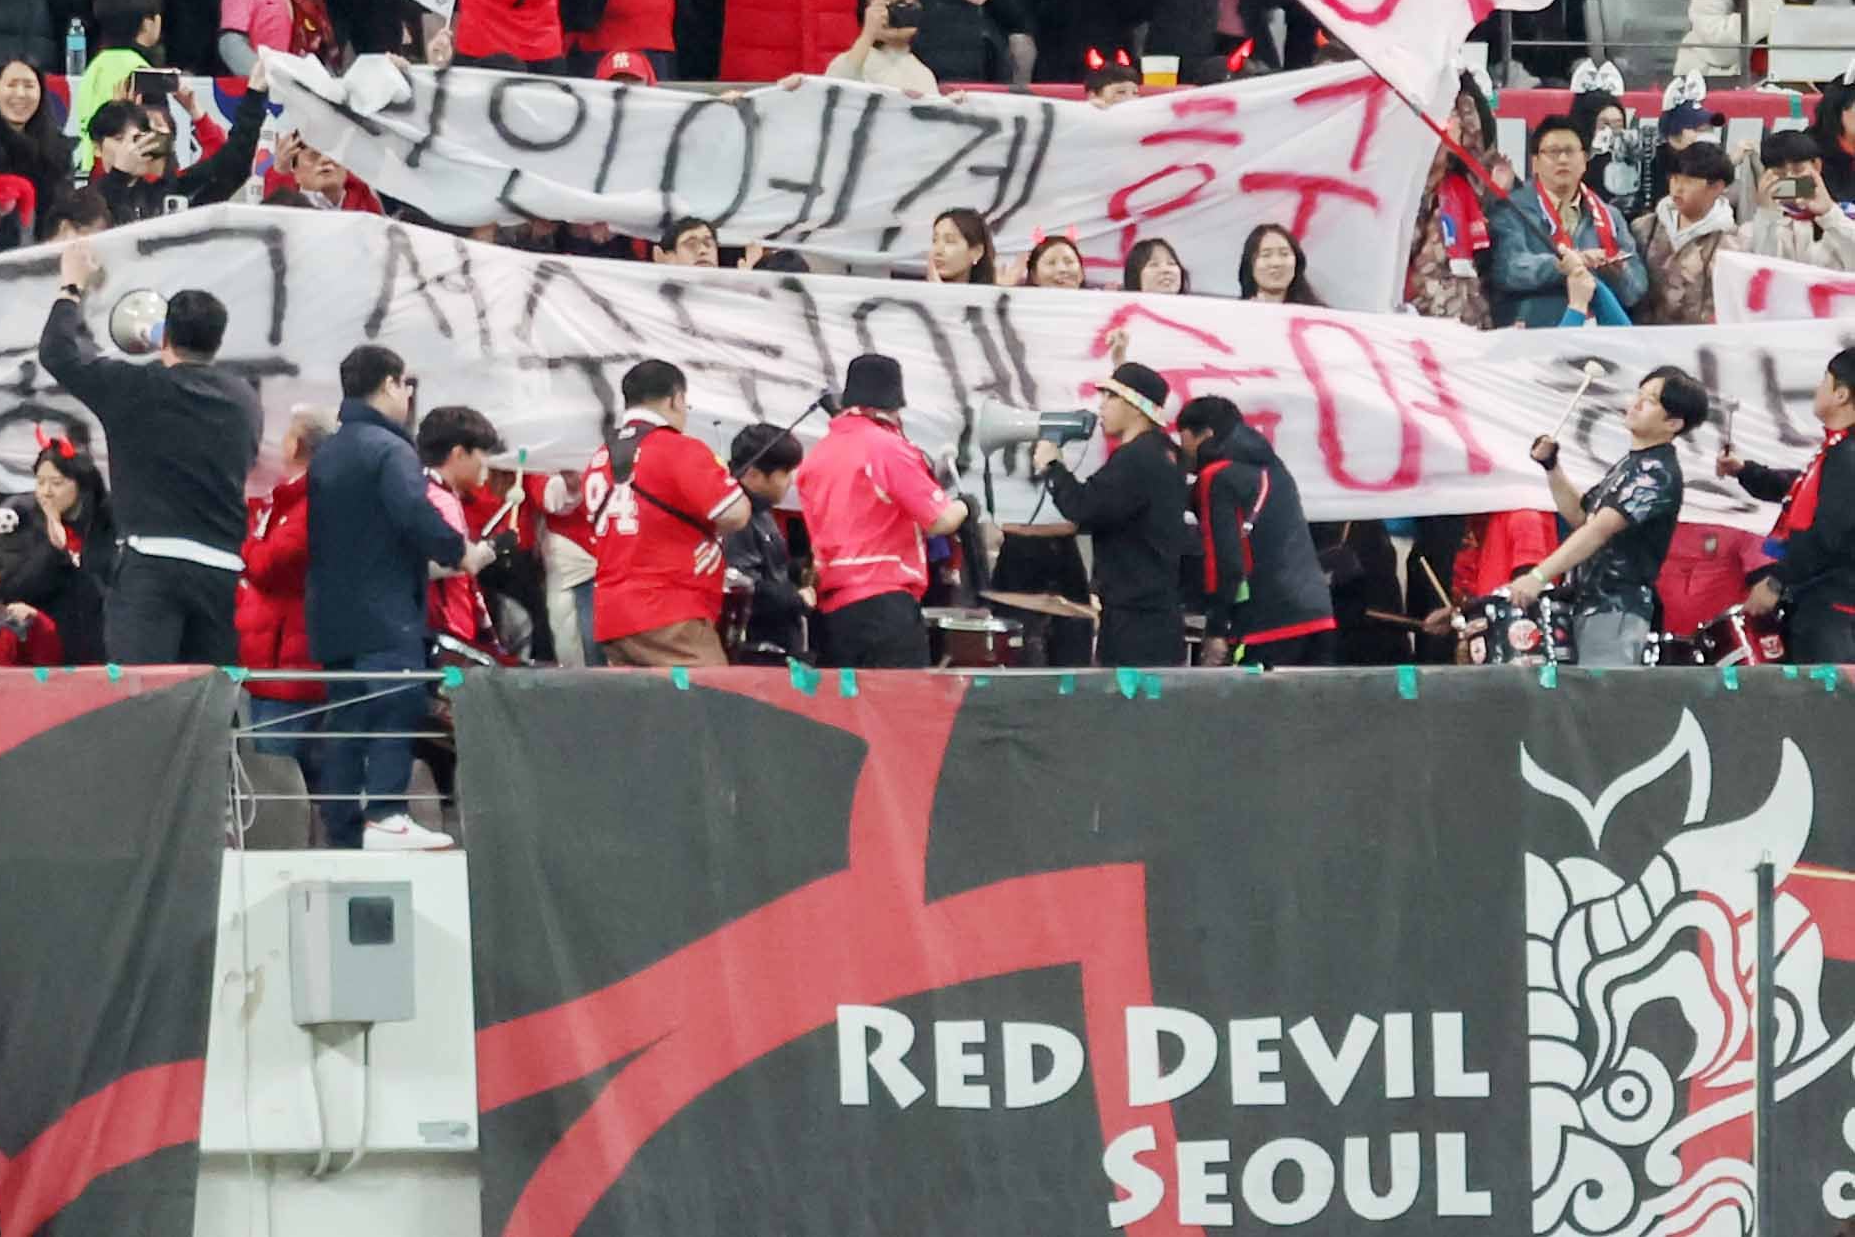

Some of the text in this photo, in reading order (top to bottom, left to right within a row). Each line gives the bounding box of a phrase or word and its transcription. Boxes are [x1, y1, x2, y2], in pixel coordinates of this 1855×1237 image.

[836, 1003, 1492, 1110] RED DEVIL
[1102, 1123, 1493, 1228] SEOUL
